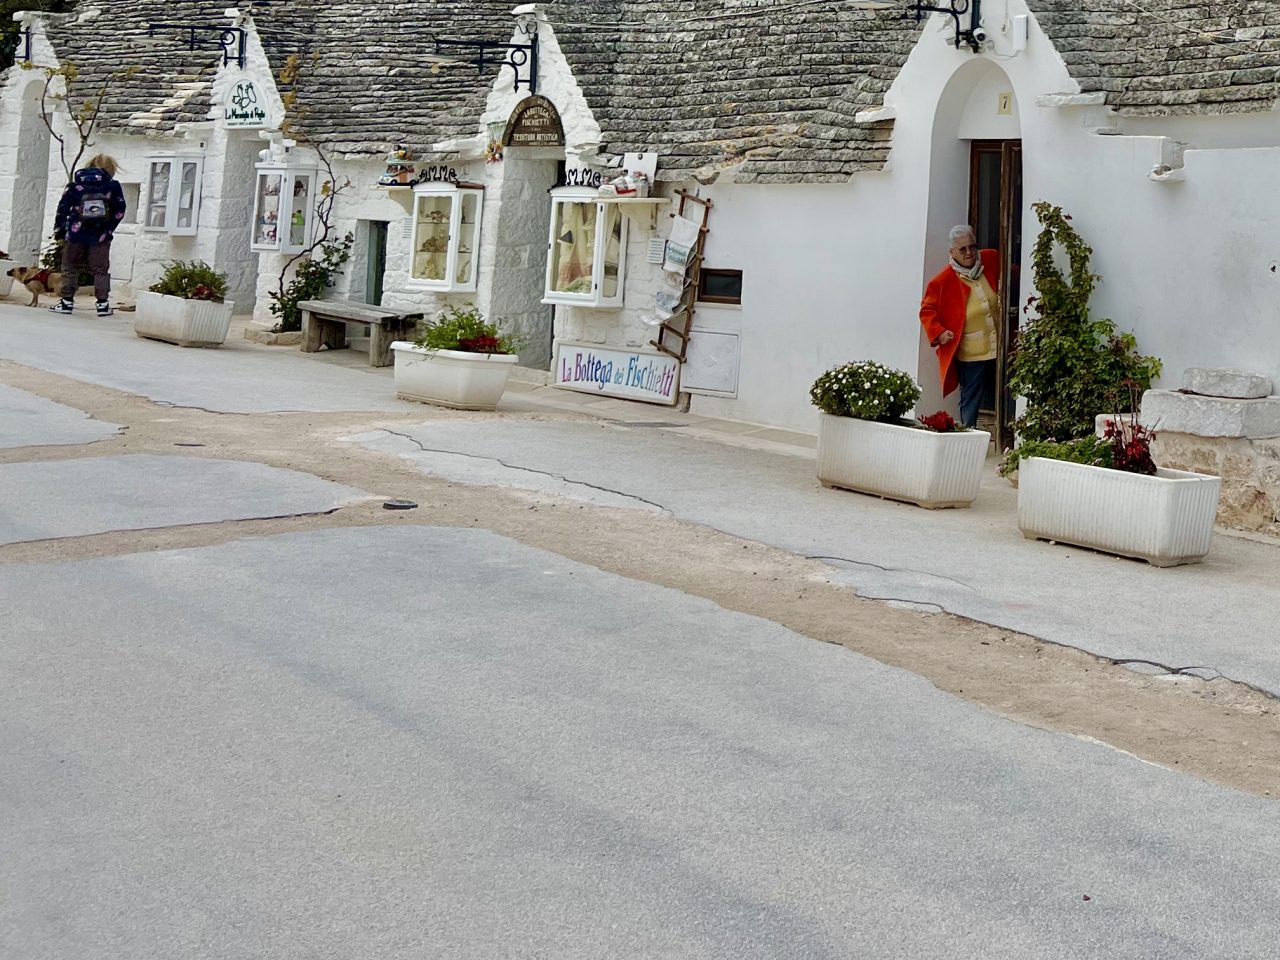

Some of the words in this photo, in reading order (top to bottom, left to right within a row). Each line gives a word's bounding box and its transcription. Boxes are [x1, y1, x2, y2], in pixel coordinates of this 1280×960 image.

[1002, 95, 1008, 110] 7
[536, 133, 558, 141] ARTISTICA
[561, 357, 572, 383] La
[574, 351, 613, 390] Bottega
[614, 367, 625, 385] dei
[625, 354, 677, 397] Fischietti
